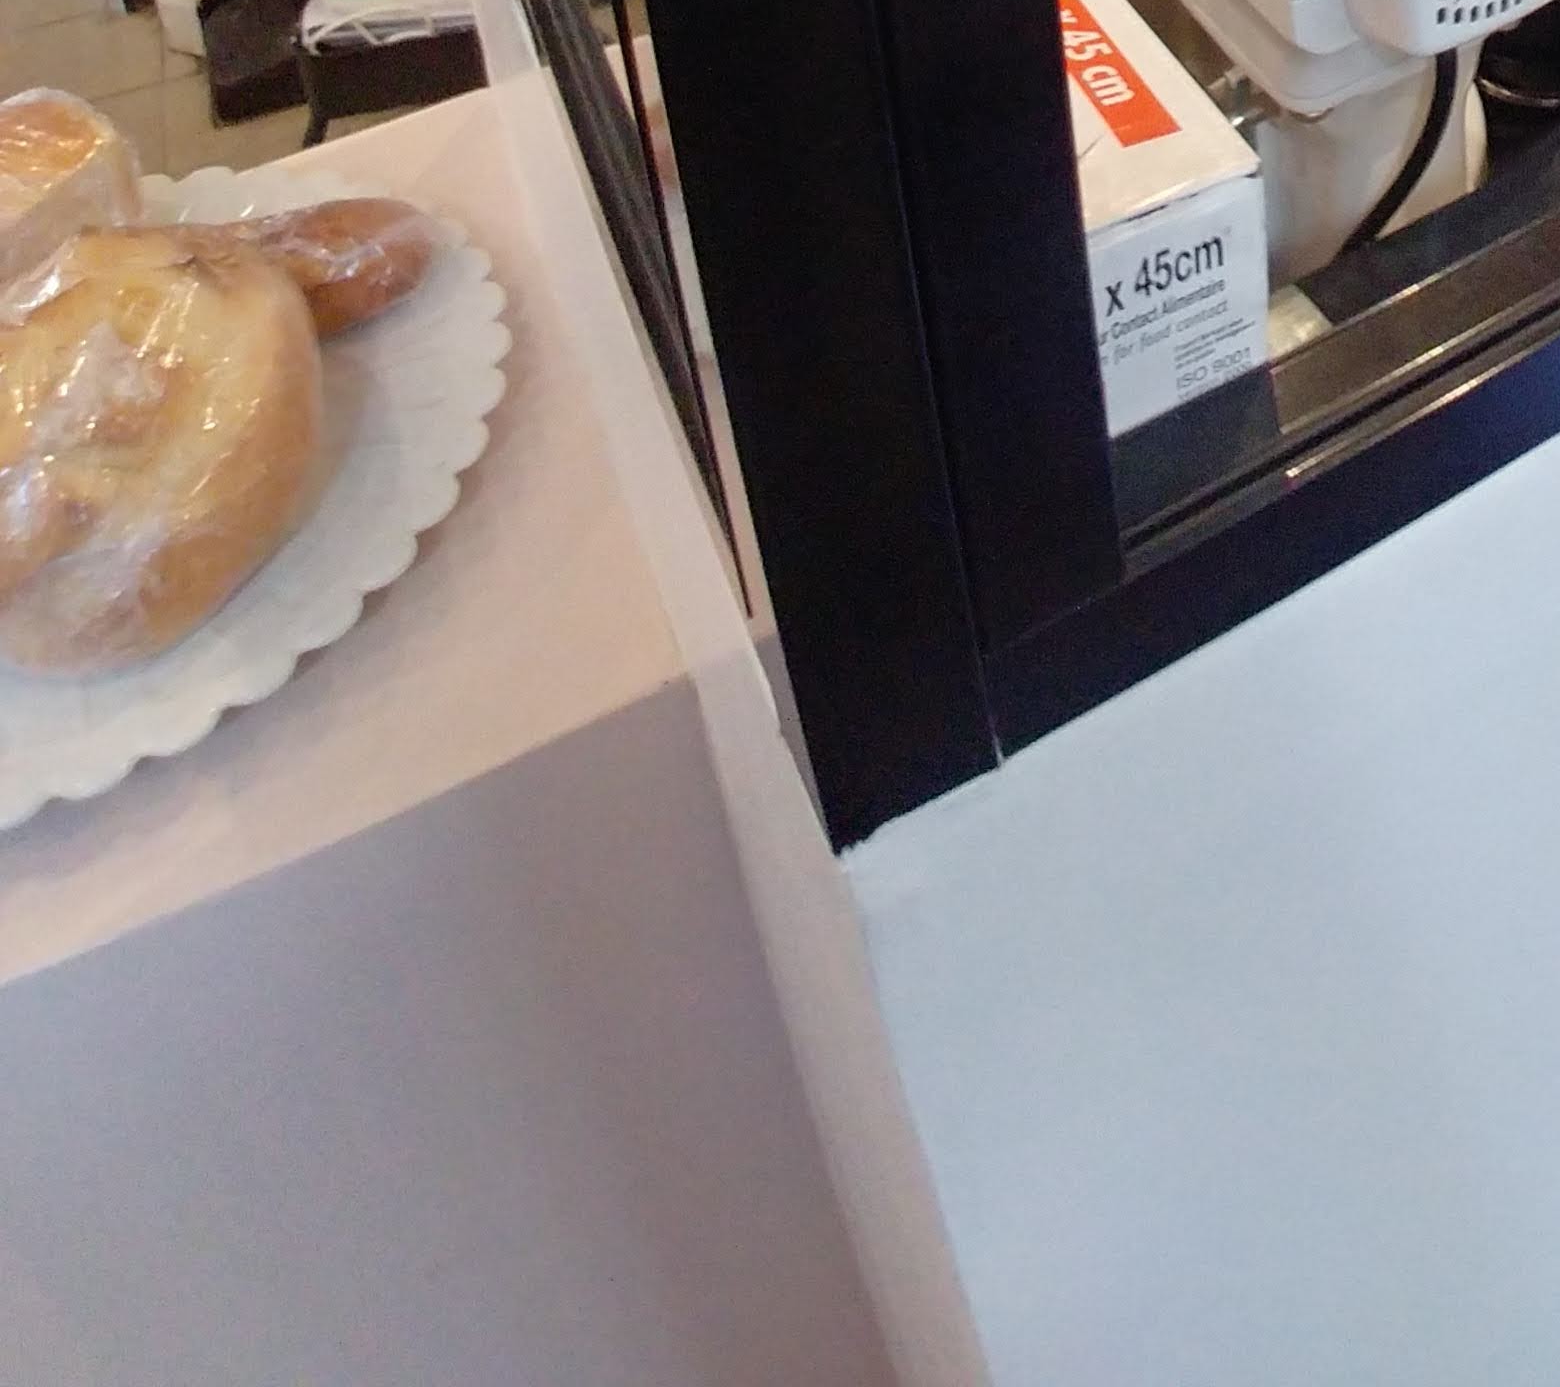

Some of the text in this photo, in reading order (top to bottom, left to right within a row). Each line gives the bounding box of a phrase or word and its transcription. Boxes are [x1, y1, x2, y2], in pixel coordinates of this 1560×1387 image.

[1062, 30, 1114, 62] 45
[1080, 64, 1136, 107] cm
[1104, 235, 1225, 318] x 45cm
